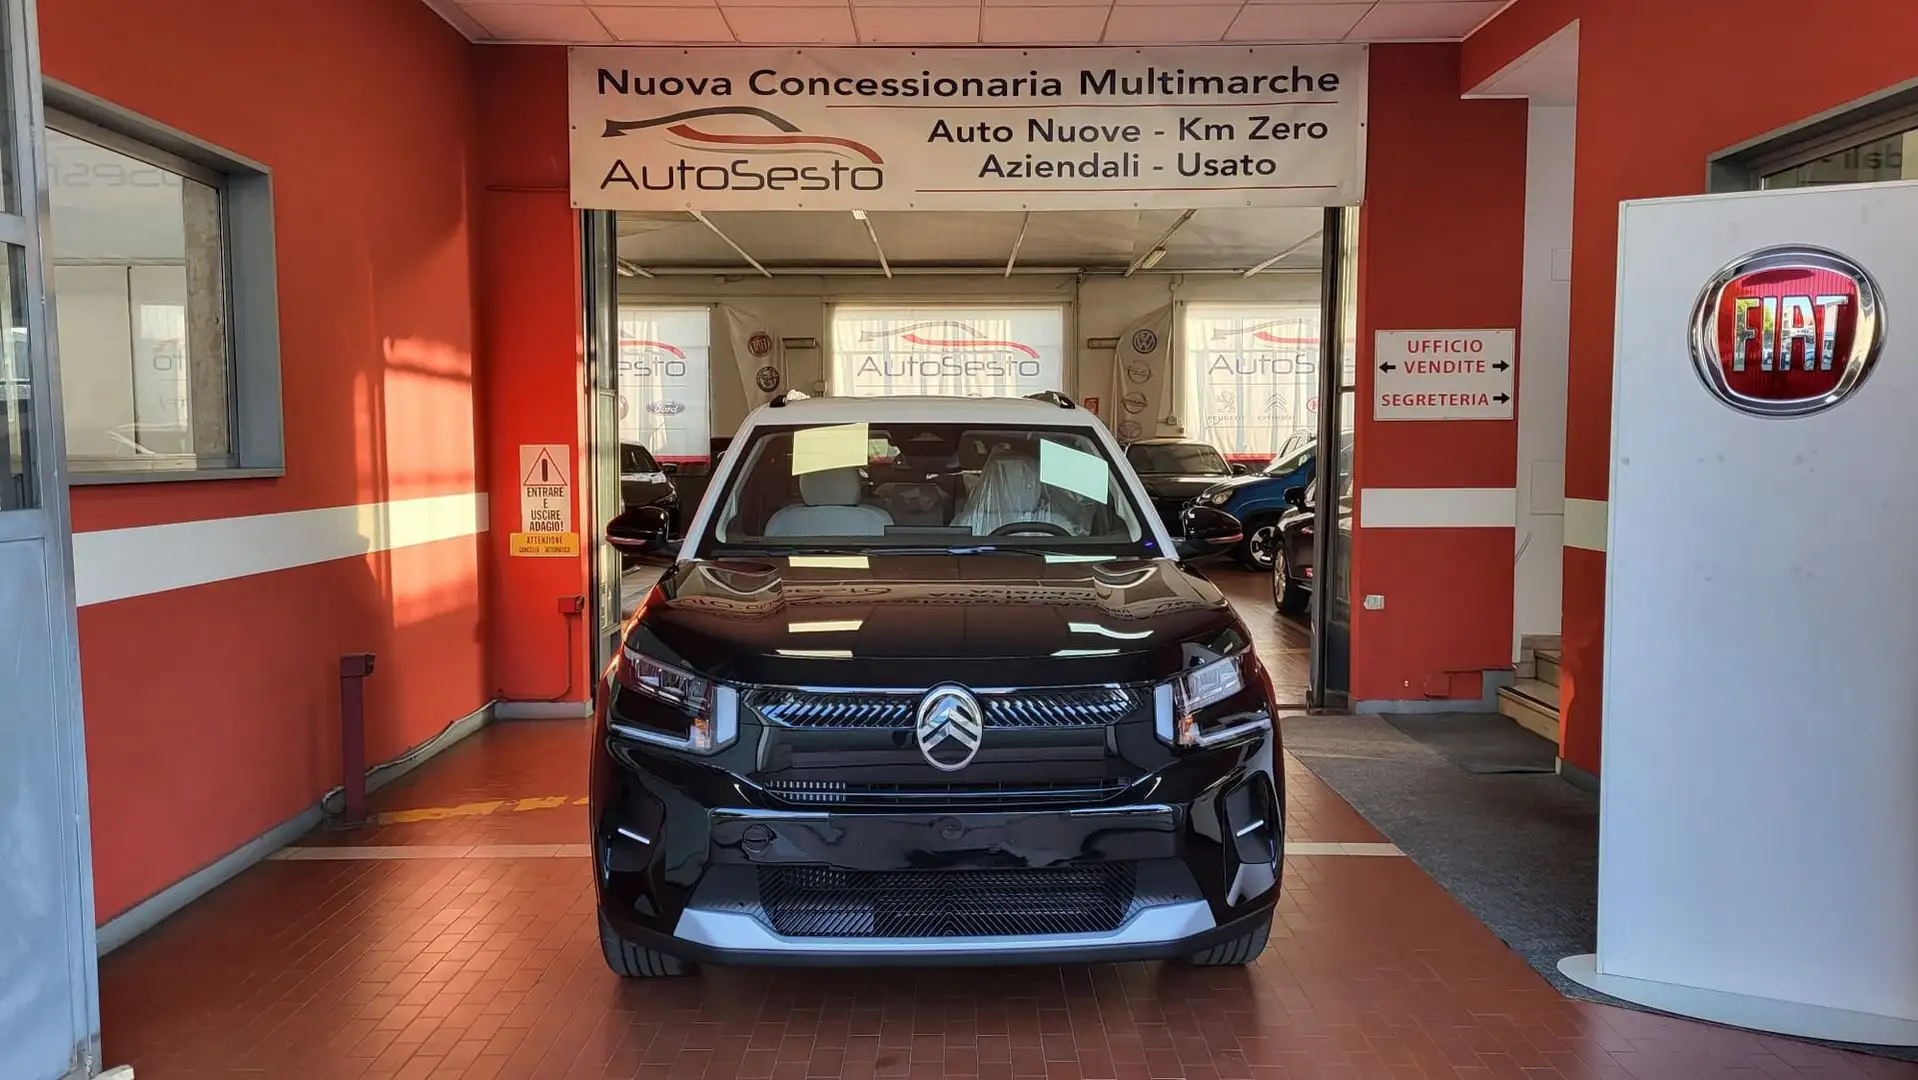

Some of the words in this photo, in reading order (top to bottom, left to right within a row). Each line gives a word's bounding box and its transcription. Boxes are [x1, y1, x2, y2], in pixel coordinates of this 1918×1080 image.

[597, 68, 732, 96] Nuova
[749, 69, 1062, 98] Concessionaria
[1080, 66, 1340, 96] Multimarche
[927, 118, 1013, 143] Auto
[1028, 117, 1141, 143] Nuove
[1179, 116, 1234, 142] Km
[1248, 116, 1328, 140] Zero
[600, 158, 883, 191] AutoSesto
[978, 152, 1139, 179] Aziendali
[1177, 152, 1276, 178] Usato
[1732, 294, 1849, 372] FIAT
[1407, 339, 1483, 354] UFFICIO
[857, 355, 1040, 377] AutoSesto
[1208, 353, 1316, 375] AutoS
[1404, 360, 1486, 374] VENDITE
[1381, 393, 1489, 407] SEGRETERIA
[527, 487, 564, 498] ENTRARE
[543, 499, 548, 509] E
[530, 509, 561, 521] USCIRE
[529, 521, 564, 532] ADAGIO!
